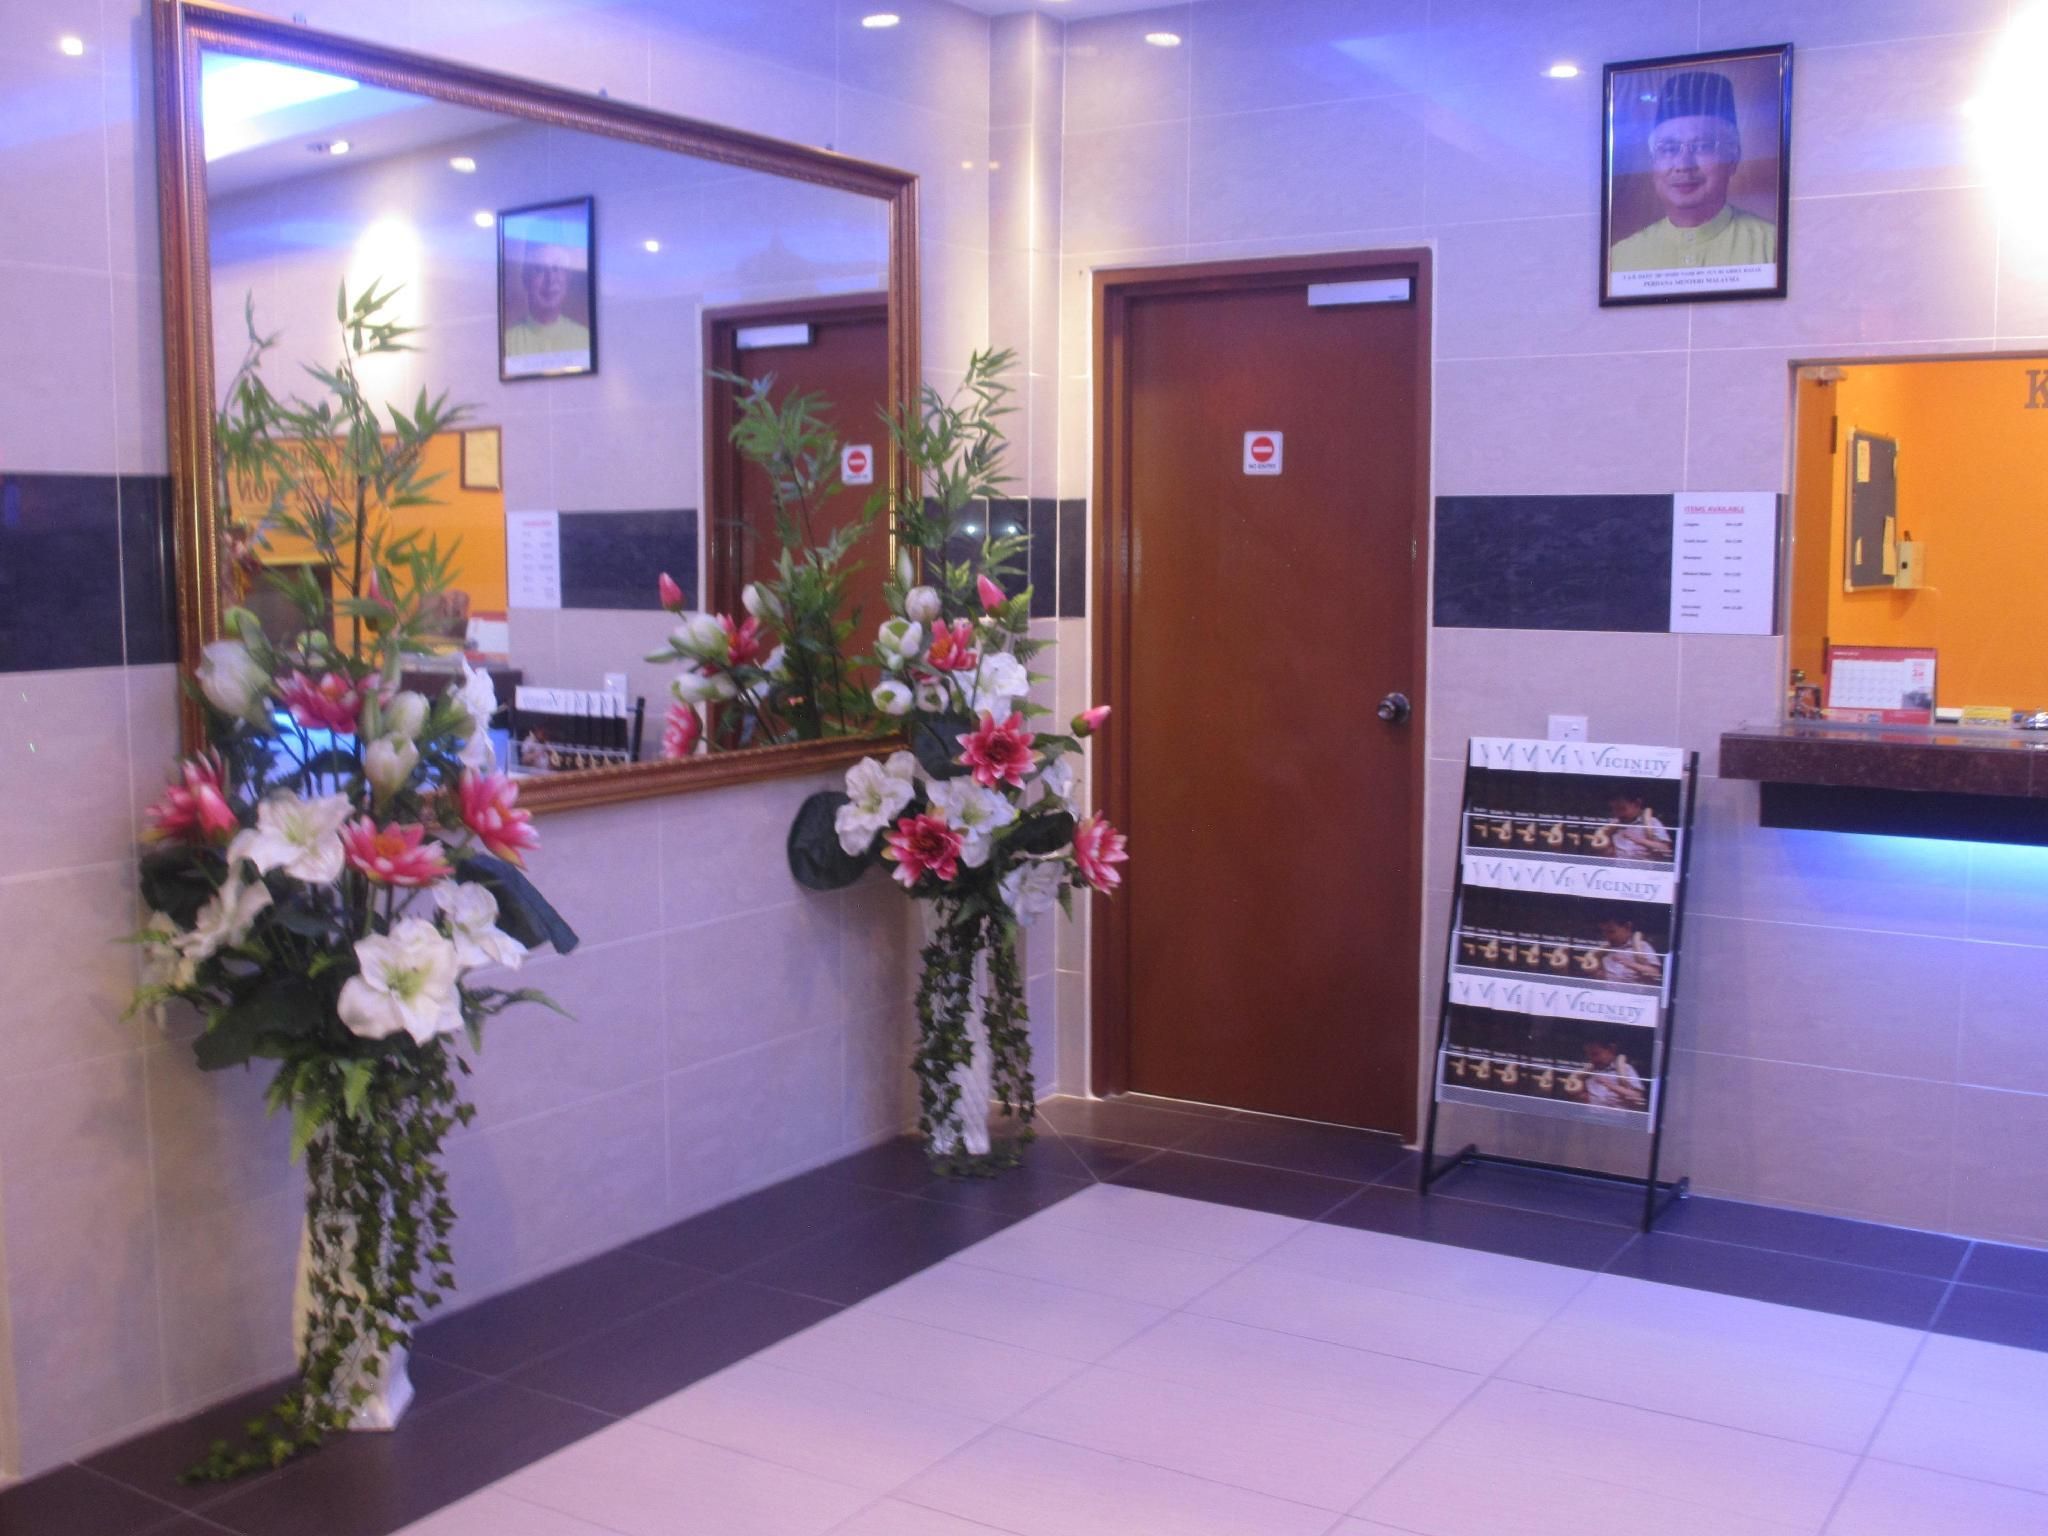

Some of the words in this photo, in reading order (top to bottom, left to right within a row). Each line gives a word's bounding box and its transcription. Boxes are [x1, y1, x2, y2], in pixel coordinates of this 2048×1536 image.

[1684, 506, 1705, 514] ITEMS
[1707, 506, 1744, 514] AVAILABLE
[1591, 746, 1671, 777] VICINITY
[1582, 869, 1662, 901] VICINITY
[1565, 991, 1645, 1023] VICINITY
